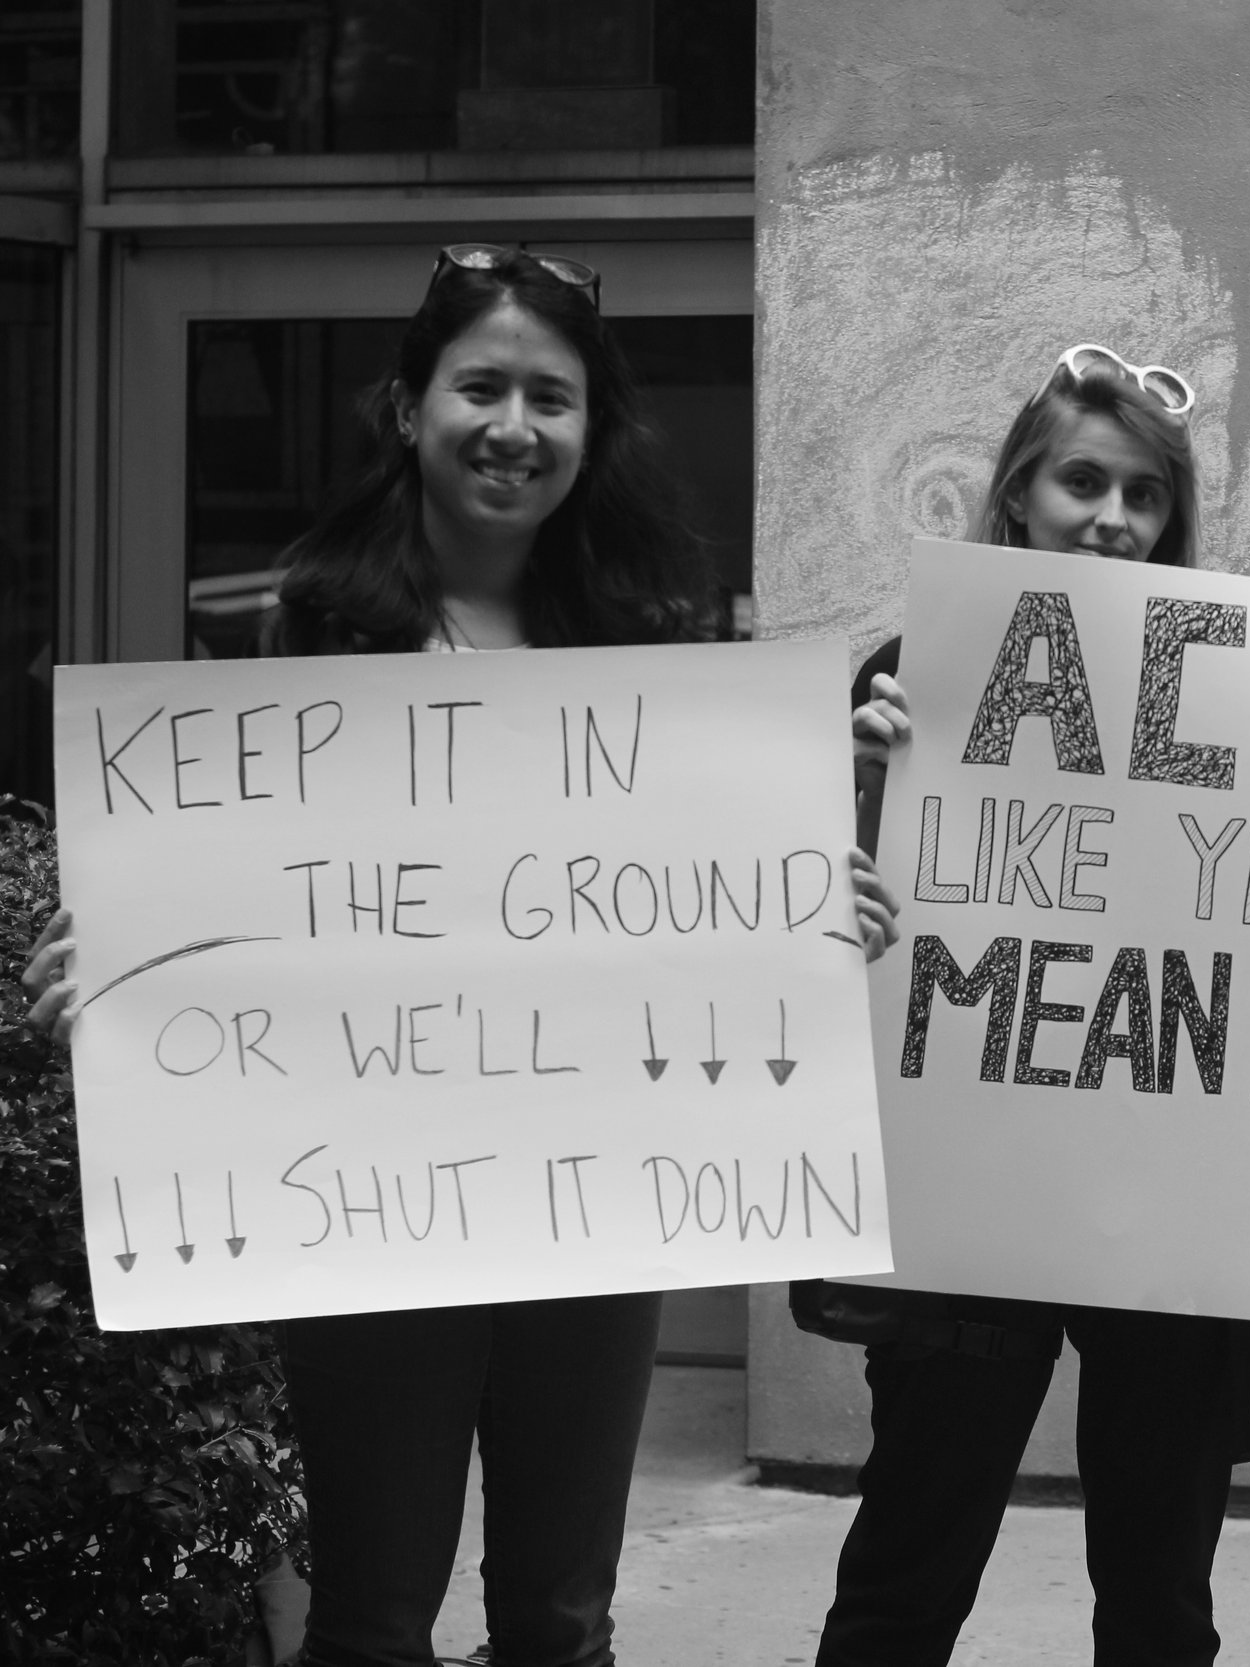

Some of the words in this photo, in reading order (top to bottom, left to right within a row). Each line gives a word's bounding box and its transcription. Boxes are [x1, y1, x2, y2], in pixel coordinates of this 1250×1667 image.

[97, 702, 343, 813] KEEP
[409, 702, 483, 806] IT
[560, 694, 641, 798] IN
[283, 860, 447, 938] THE
[502, 849, 831, 939] GROUND
[914, 796, 1114, 912] LIKE
[155, 1006, 287, 1076] OR
[342, 994, 581, 1078] WE'LL
[900, 935, 1233, 1095] MEAN
[280, 1144, 497, 1247] SHUT
[547, 1154, 598, 1242] IT
[642, 1151, 861, 1244] DOWN
